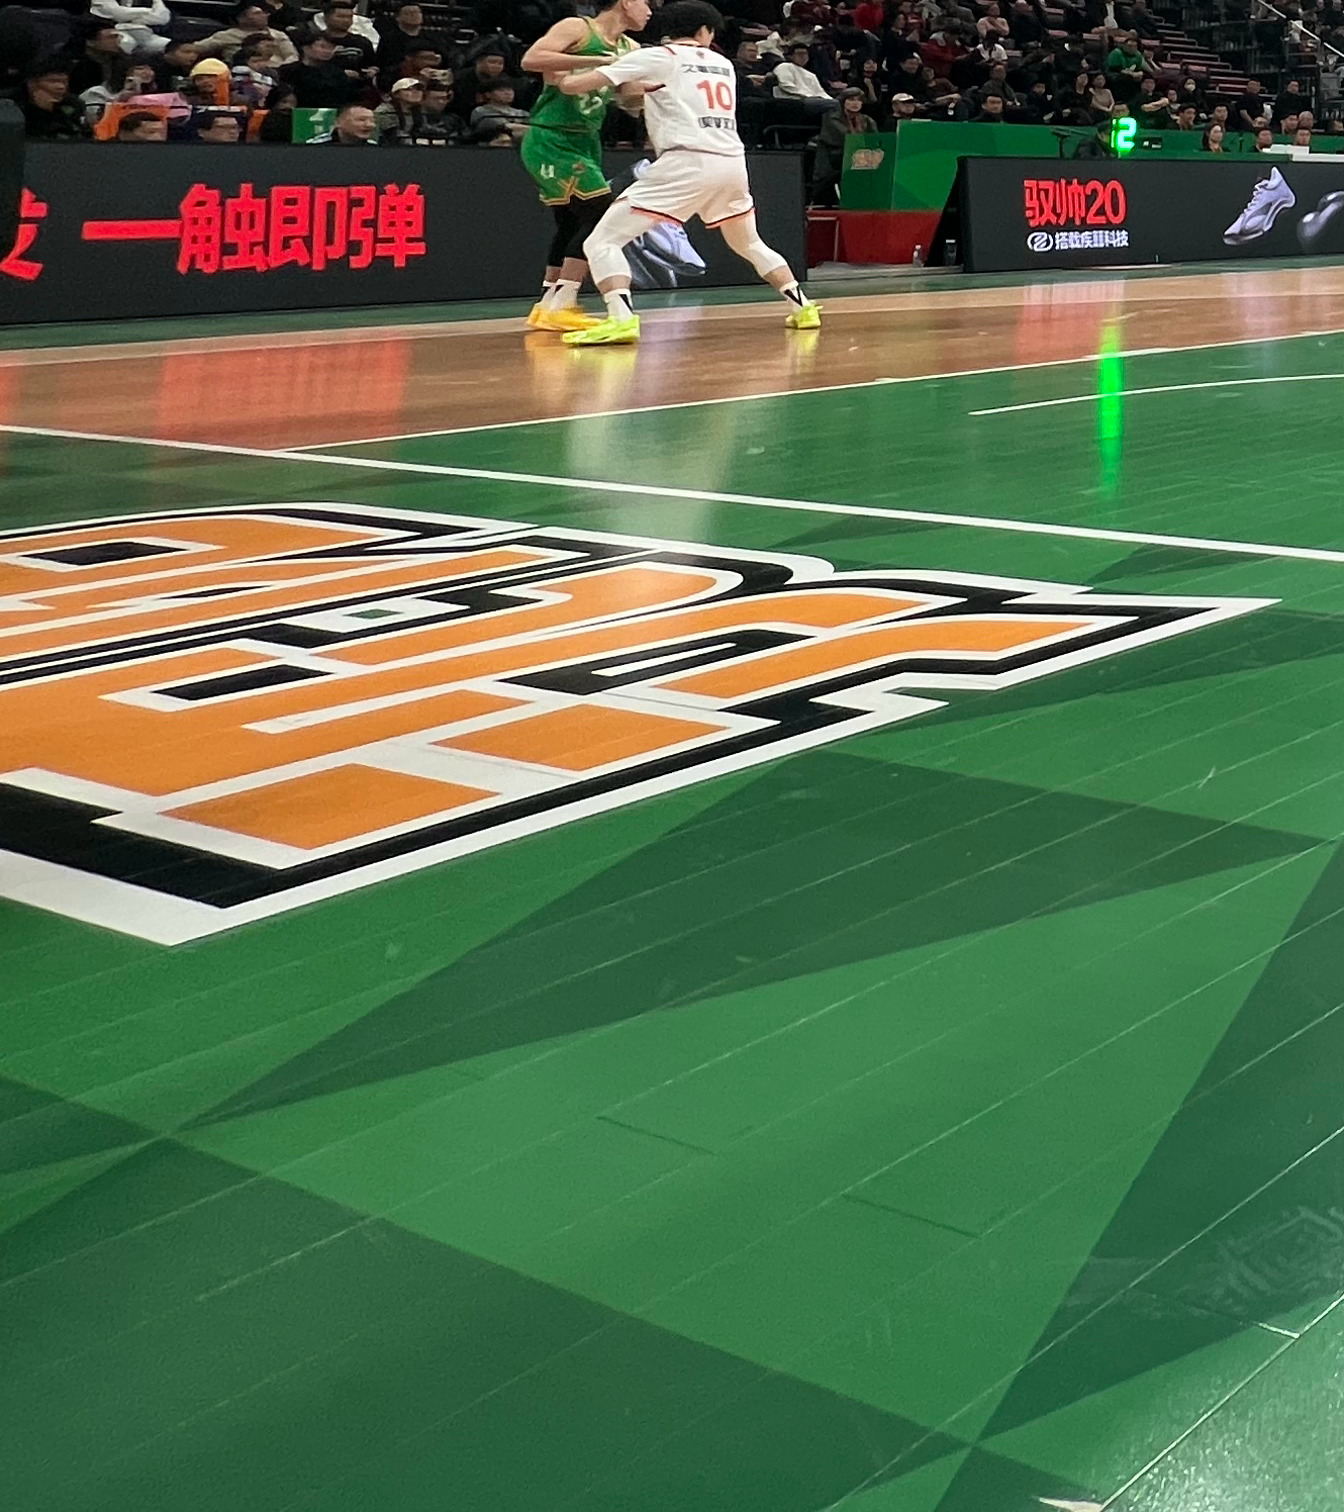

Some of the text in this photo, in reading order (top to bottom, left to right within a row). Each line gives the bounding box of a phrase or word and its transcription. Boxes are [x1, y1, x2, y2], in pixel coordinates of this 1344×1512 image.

[696, 79, 733, 111] 10
[1024, 178, 1126, 227] 驭帅20
[81, 183, 427, 275] 一触即弹
